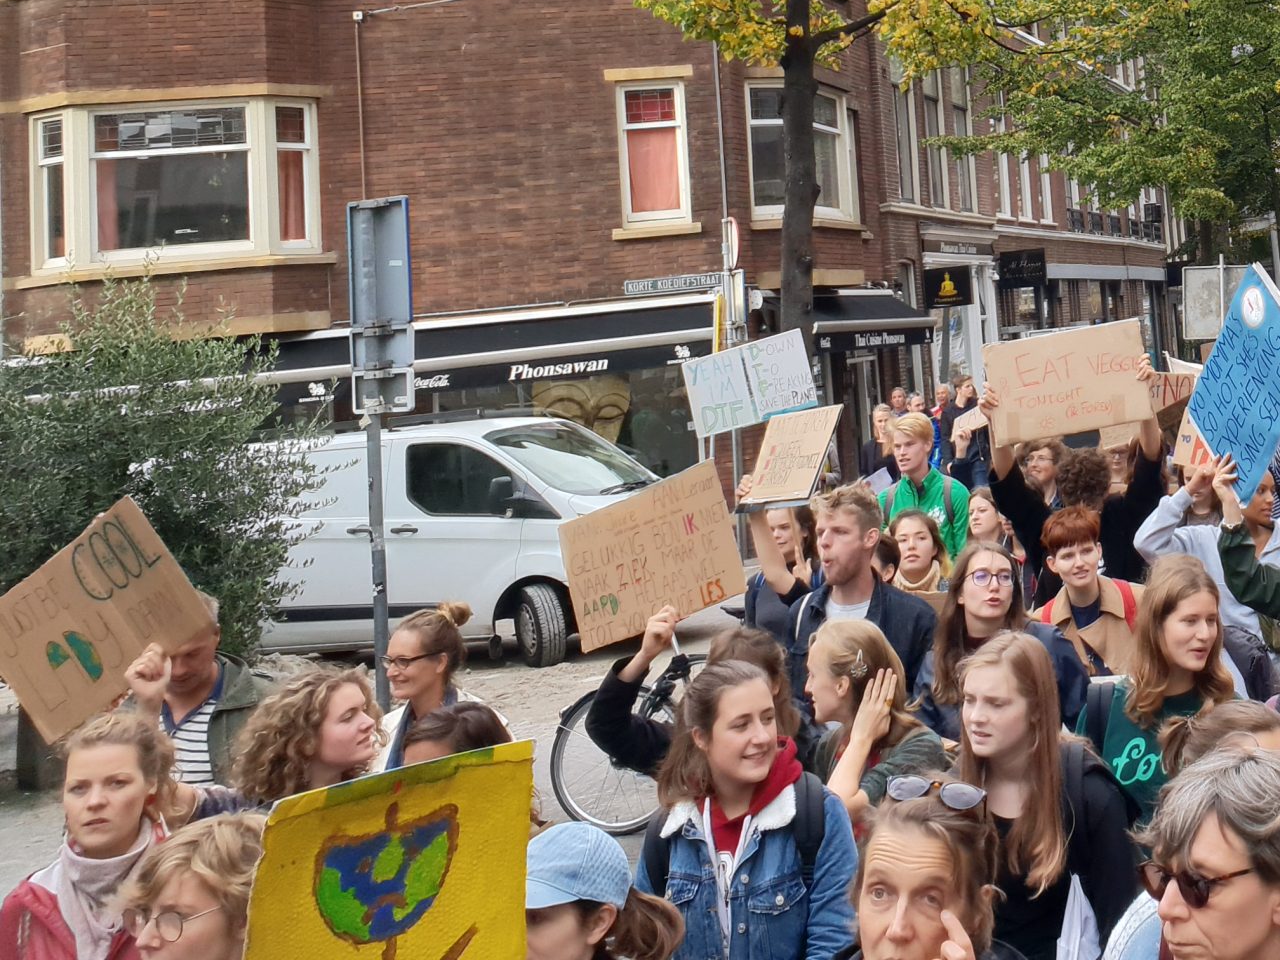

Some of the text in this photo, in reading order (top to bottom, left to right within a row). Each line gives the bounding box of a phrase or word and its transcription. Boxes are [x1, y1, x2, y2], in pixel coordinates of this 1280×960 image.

[628, 274, 720, 293] KORTE KOEDIEFSTRAAT
[855, 332, 866, 347] Thai
[509, 358, 609, 381] Phonsawan
[687, 360, 734, 387] YEAH
[1015, 352, 1075, 388] EAT
[1190, 392, 1206, 421] YO
[1199, 312, 1243, 393] MOMMA'S
[760, 398, 778, 412] SAVE
[779, 394, 792, 408] THE
[1014, 387, 1083, 409] TONIGHT
[1203, 411, 1217, 442] SO
[1235, 334, 1259, 377] SHE'S
[702, 400, 744, 434] DTF
[1259, 393, 1280, 432] SEA
[571, 502, 727, 578] GELUKKIG BEN IK NIET
[1, 515, 162, 658] JUST BE COOL
[575, 574, 613, 601] VAAK
[661, 541, 695, 568] MAAR
[635, 569, 689, 607] HELAAS
[585, 621, 615, 645] TOT
